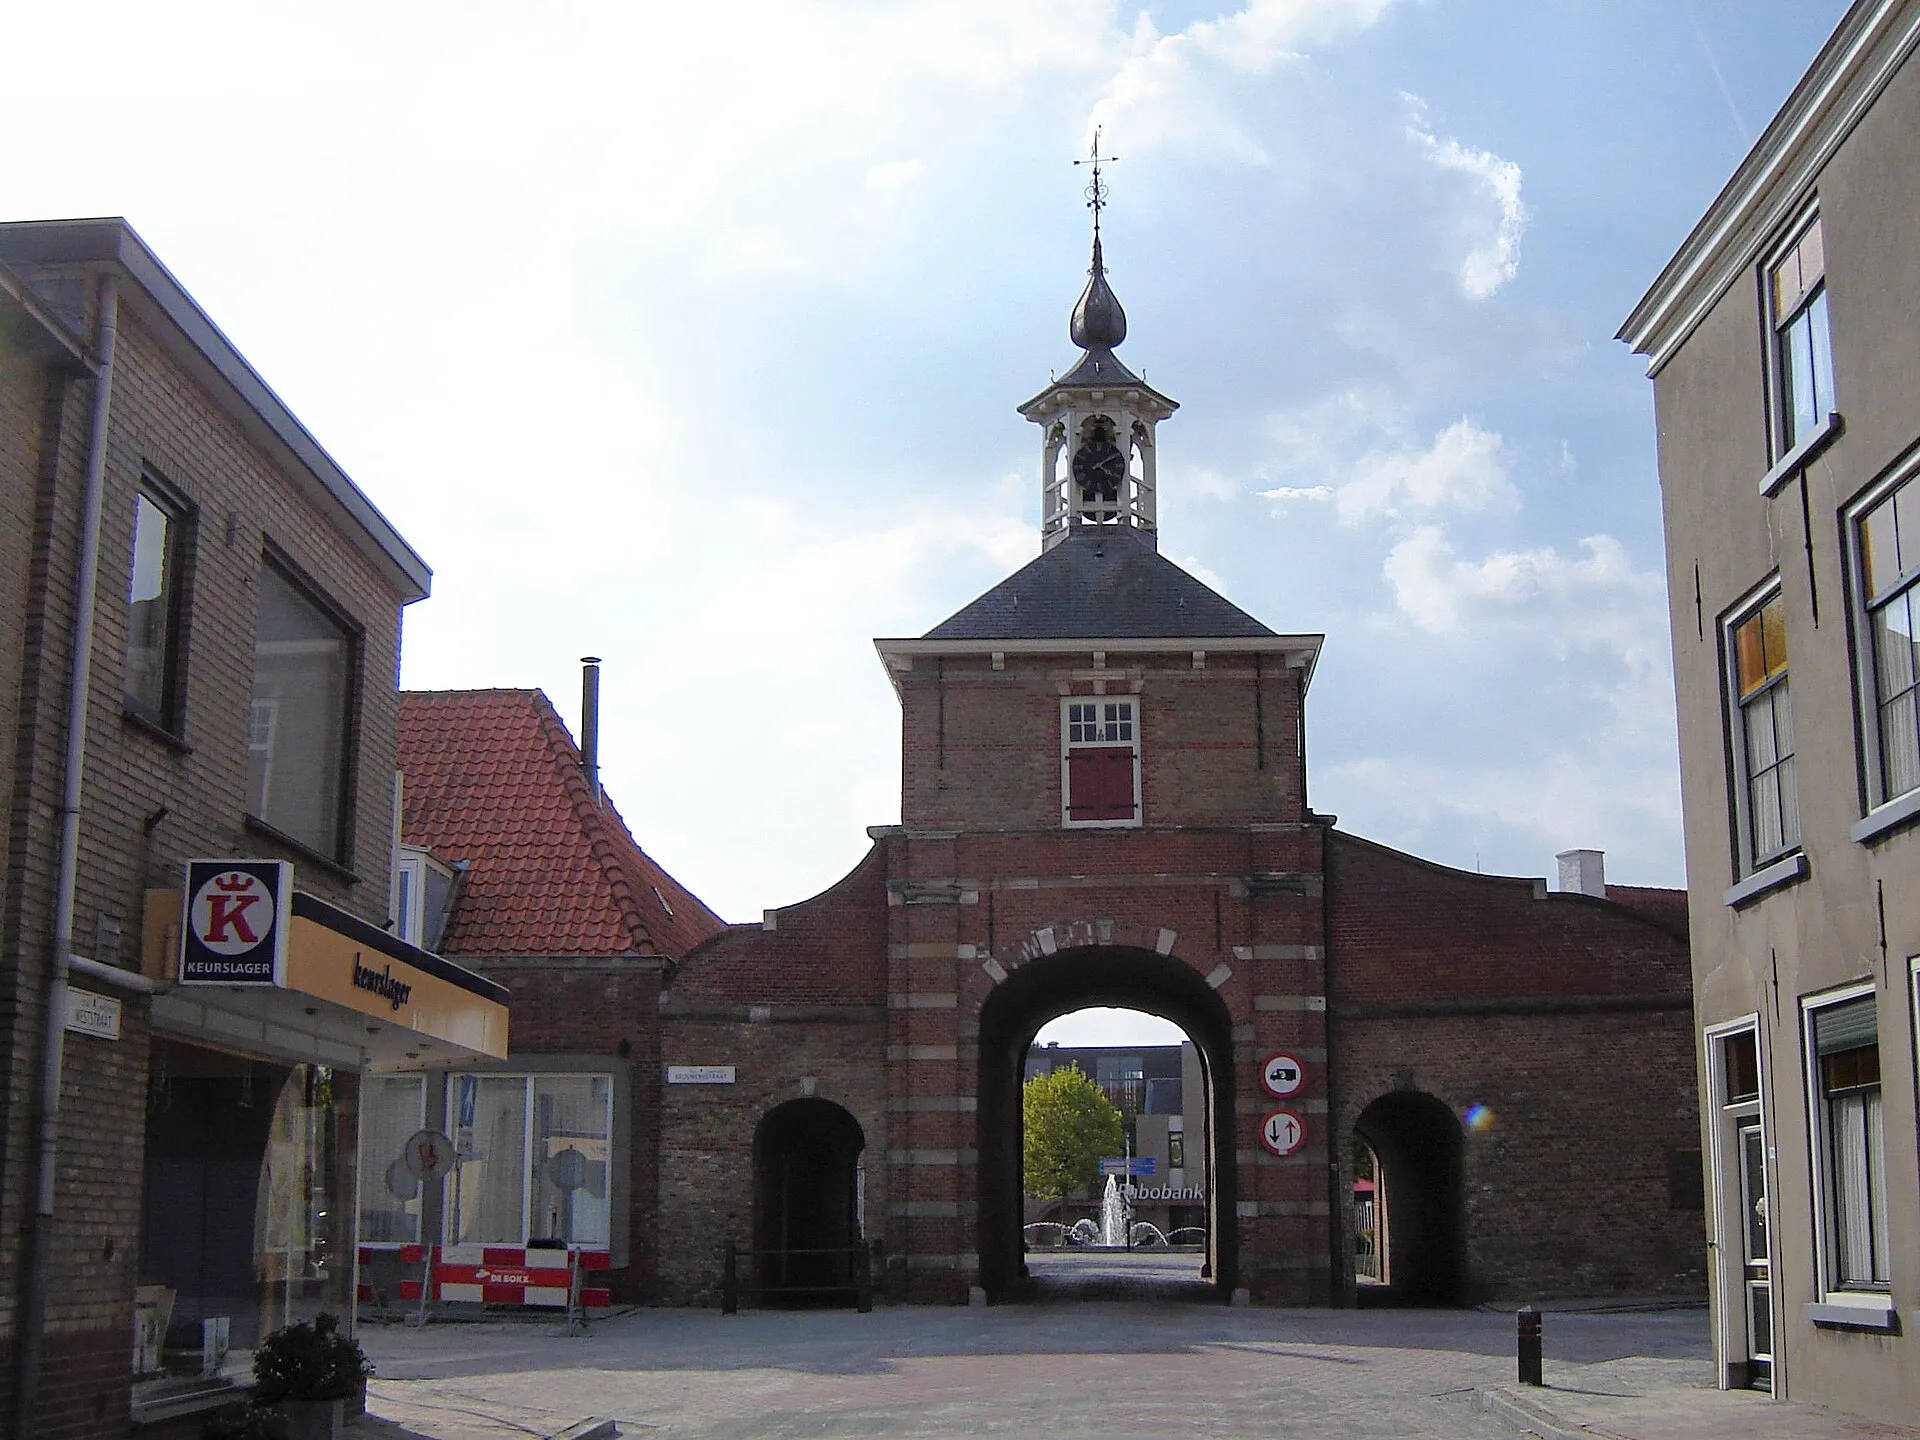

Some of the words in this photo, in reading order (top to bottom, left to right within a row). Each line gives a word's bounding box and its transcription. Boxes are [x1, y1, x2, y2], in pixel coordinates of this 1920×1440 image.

[204, 895, 259, 942] K
[187, 962, 270, 974] KEURSLAGER
[353, 952, 411, 1010] keurslager
[75, 1007, 111, 1029] WESTSTRAAT
